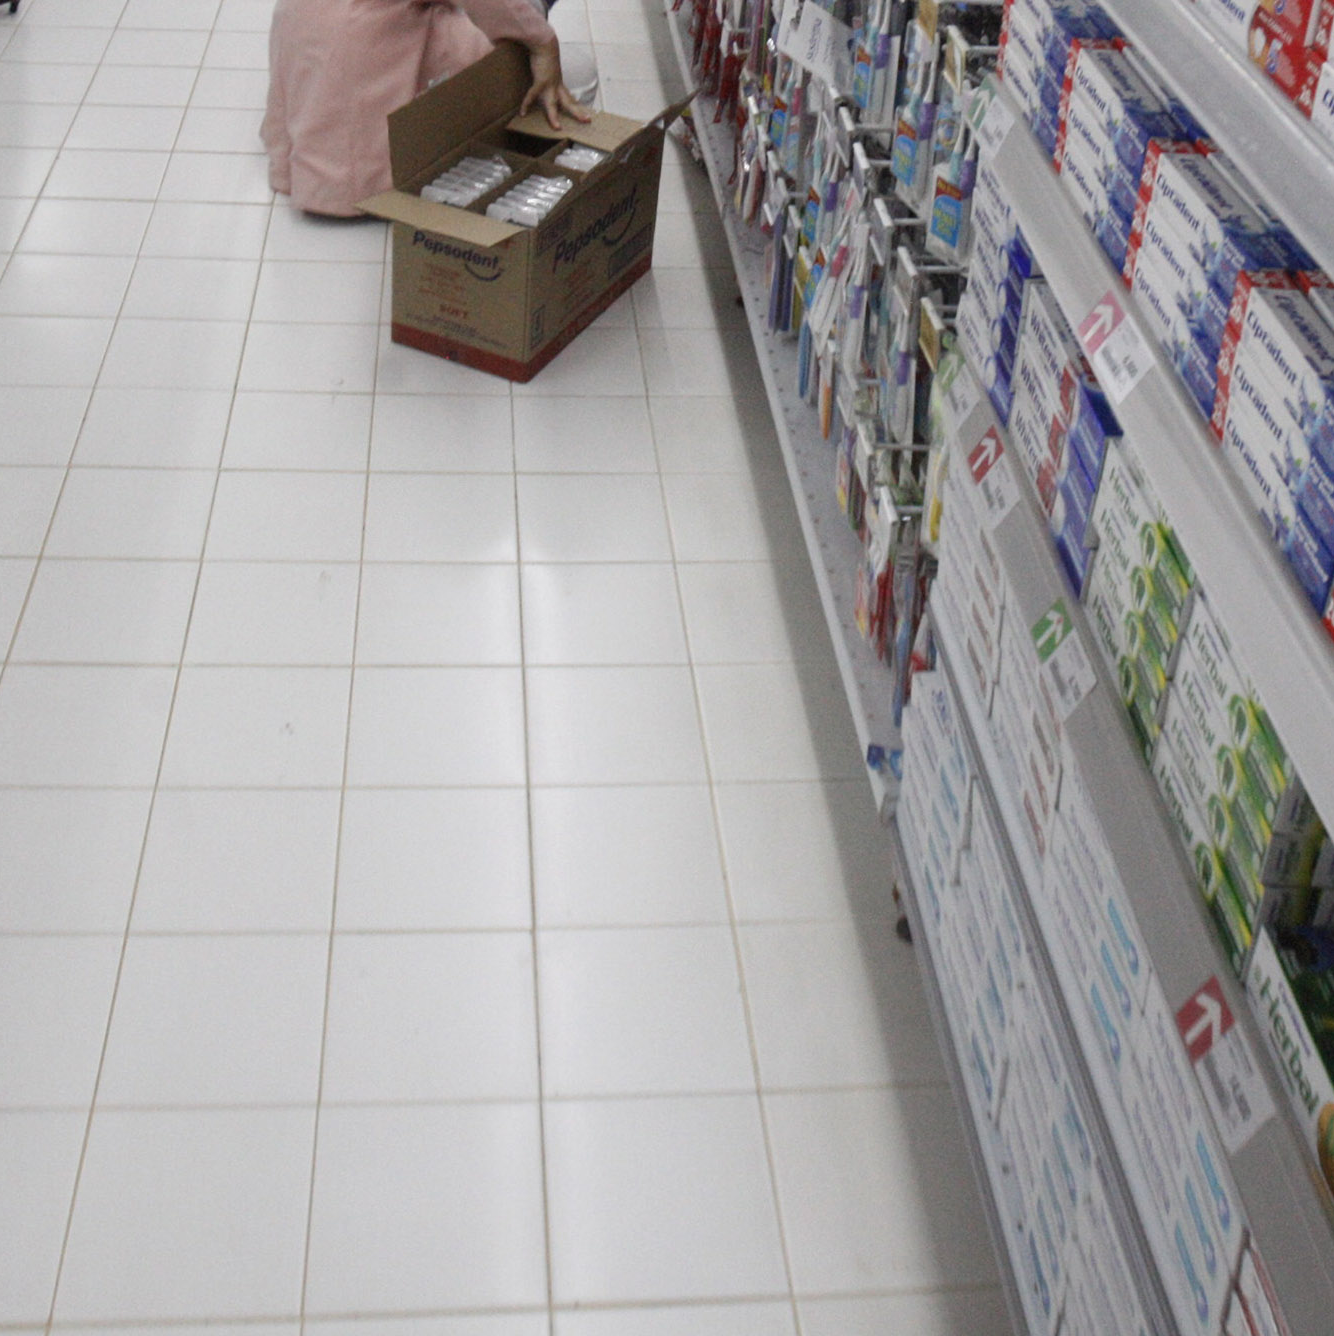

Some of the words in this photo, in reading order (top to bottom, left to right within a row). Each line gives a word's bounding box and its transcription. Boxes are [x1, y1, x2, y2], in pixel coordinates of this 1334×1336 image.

[552, 185, 641, 275] Pepsodent
[1157, 173, 1201, 232] Ciptadent
[412, 229, 500, 270] Pepsodent
[1146, 220, 1187, 281] Ciptadent
[1135, 267, 1172, 328] Ciptadent
[1247, 310, 1297, 385] Ciptadent
[1234, 364, 1284, 441] Ciptadent
[1227, 418, 1273, 501] Ciptadent
[1257, 972, 1321, 1117] Herbal
